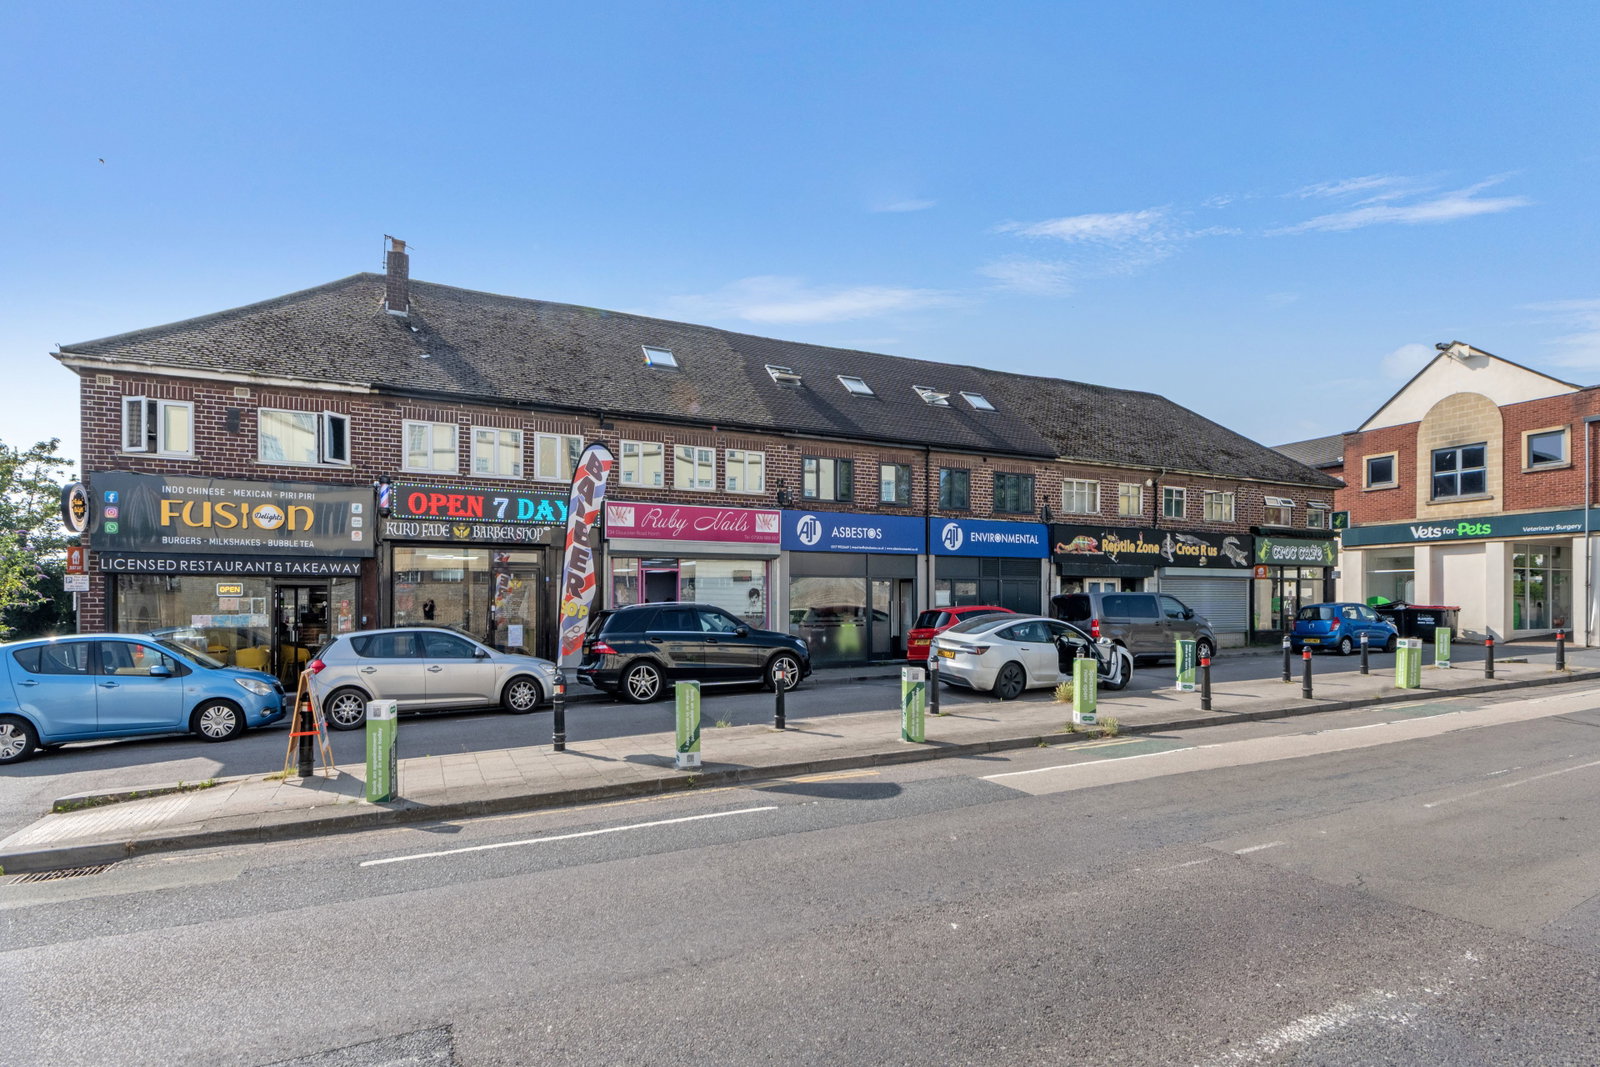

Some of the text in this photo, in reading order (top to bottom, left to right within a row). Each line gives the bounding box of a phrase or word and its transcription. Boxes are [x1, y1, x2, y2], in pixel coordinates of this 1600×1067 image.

[162, 485, 185, 494] INDO
[186, 486, 225, 496] CHINESE
[233, 488, 273, 499] MEXICAN
[280, 491, 297, 499] PIRI
[298, 492, 315, 500] PIRI
[407, 492, 484, 517] OPEN
[493, 497, 509, 519] 7
[254, 512, 283, 523] Delights
[641, 508, 750, 536] Ruby Nails
[384, 521, 420, 537] KURD
[420, 522, 450, 537] FADE
[472, 525, 517, 540] BARBER
[566, 452, 603, 599] BABER
[831, 526, 882, 539] ASBESTOS
[1410, 522, 1492, 539] Vets for Pets
[162, 536, 202, 545] BURGERS
[209, 537, 261, 547] MILKSHAKES
[267, 539, 299, 548] BUBBLE
[300, 540, 315, 548] TEA
[970, 532, 1039, 544] ENVIRONMENTAL
[1101, 538, 1160, 555] Reptile Zone
[1176, 542, 1218, 557] Crocs R us
[101, 558, 360, 573] LICENSED RESTAURANT & TAKEAWAY
